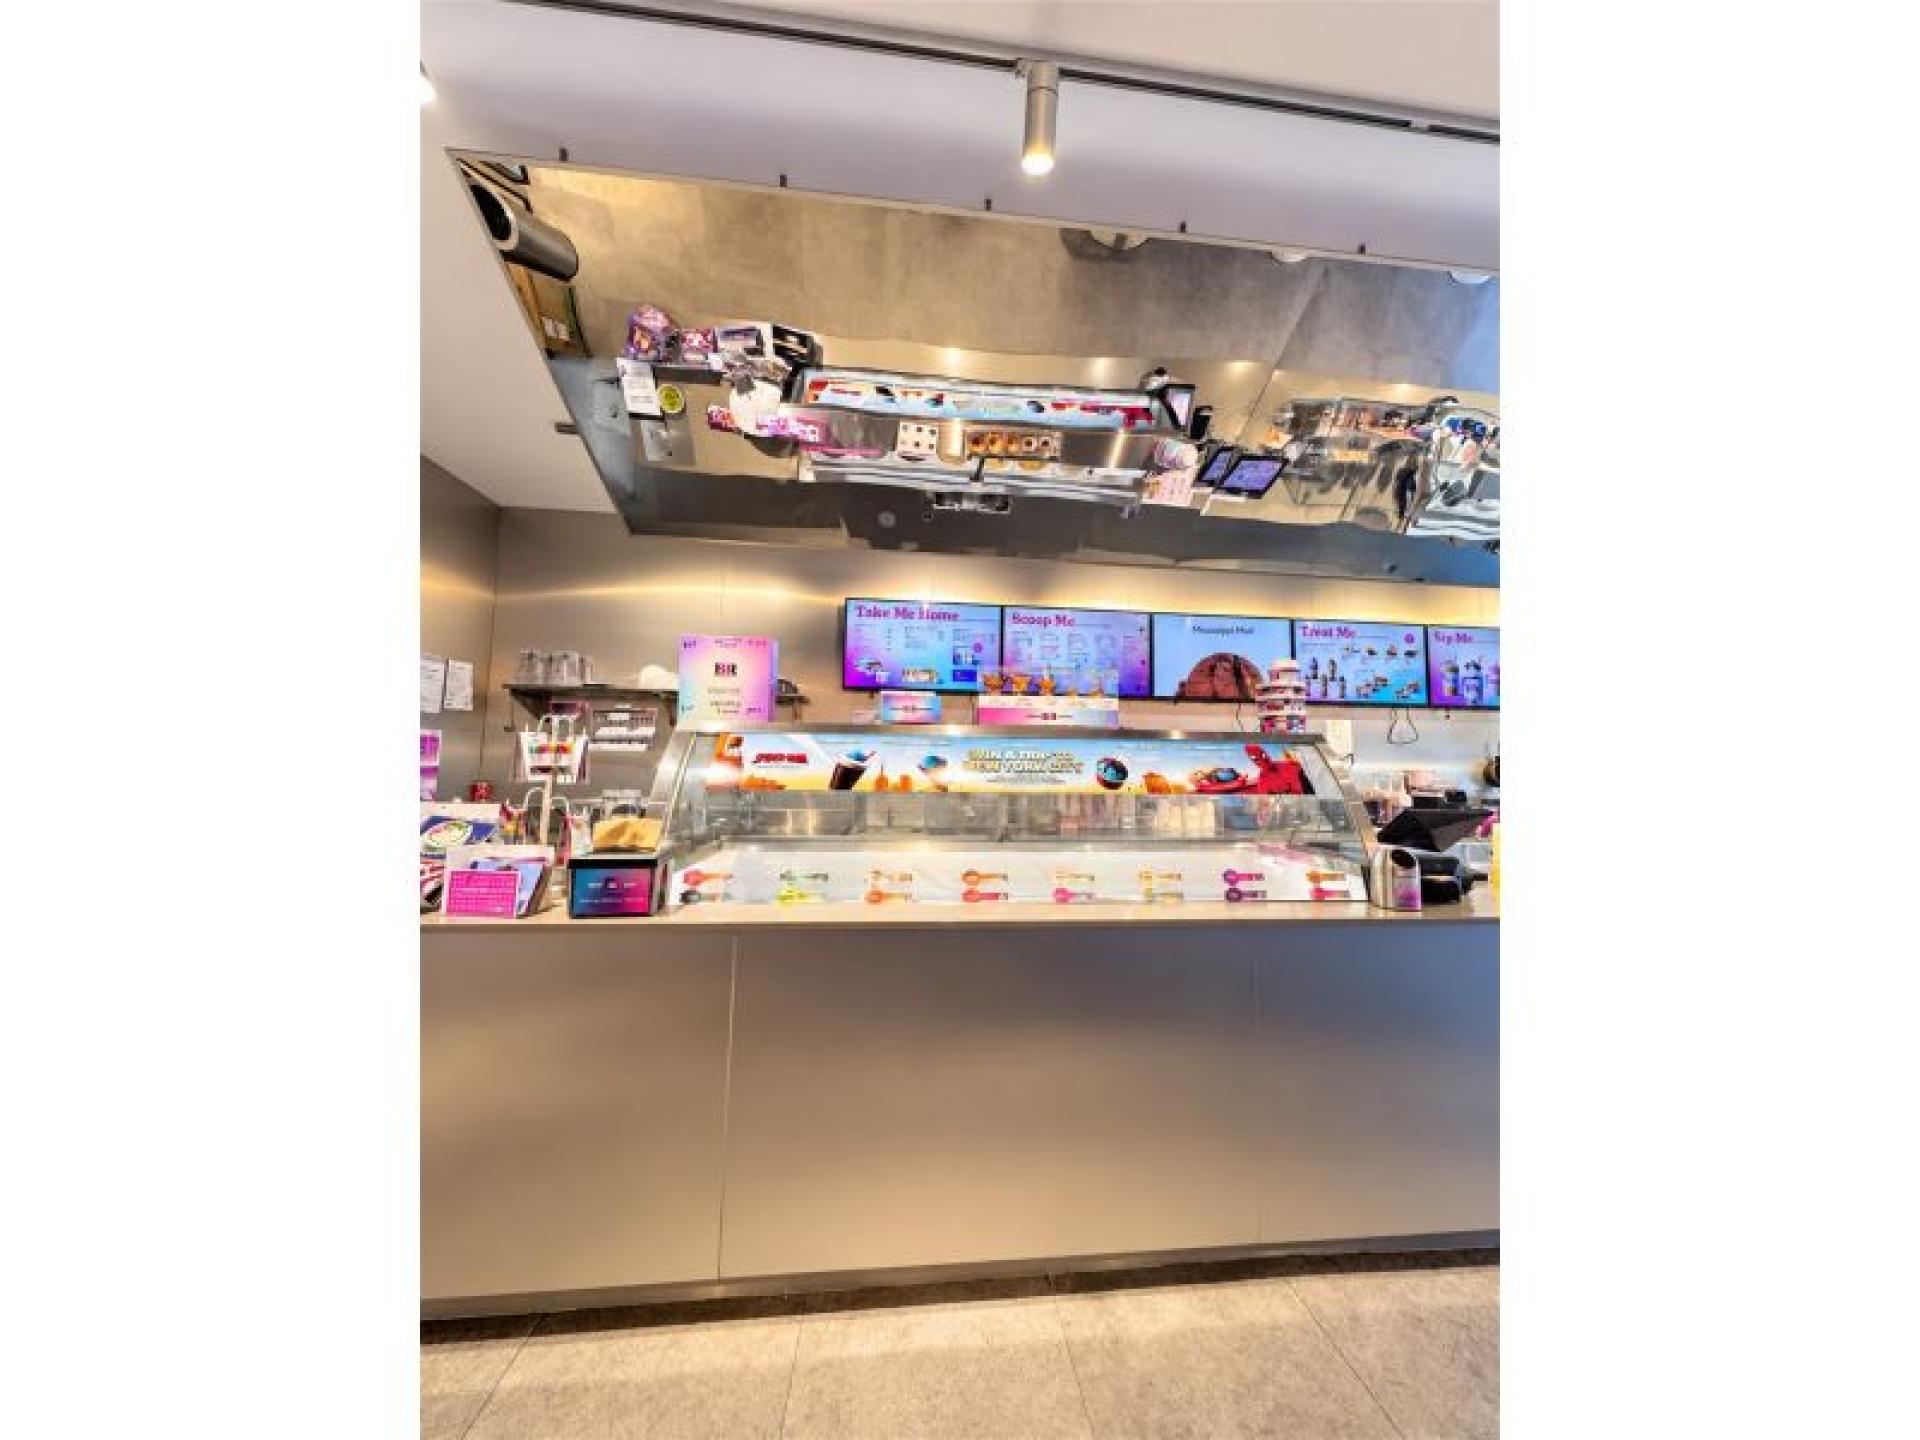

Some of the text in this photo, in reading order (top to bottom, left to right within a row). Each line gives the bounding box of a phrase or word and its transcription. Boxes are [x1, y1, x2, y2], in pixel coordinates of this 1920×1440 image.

[855, 605, 890, 618] Take
[894, 606, 915, 620] Me
[1055, 614, 1075, 627] Me
[1336, 626, 1356, 639] Me
[1456, 632, 1474, 644] Me
